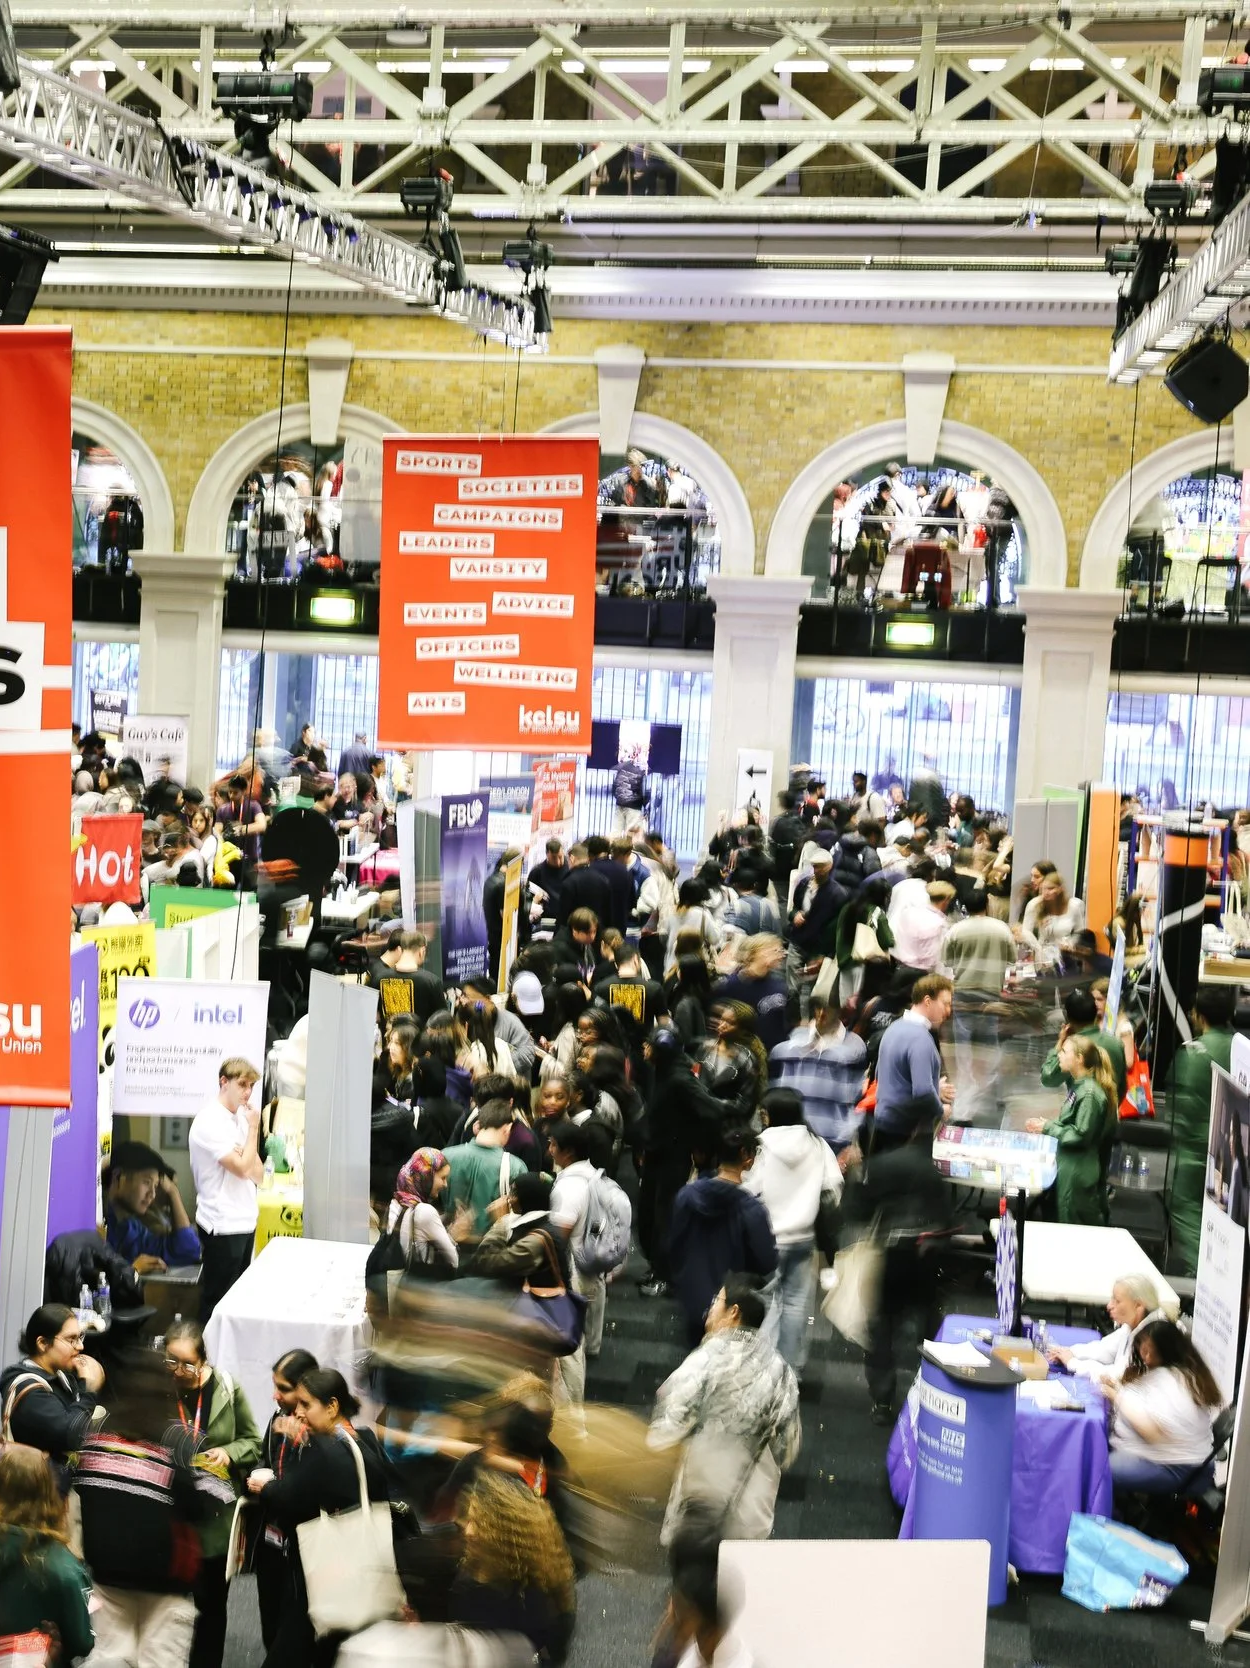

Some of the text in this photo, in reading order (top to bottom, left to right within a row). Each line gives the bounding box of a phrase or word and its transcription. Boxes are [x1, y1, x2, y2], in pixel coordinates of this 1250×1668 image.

[400, 455, 478, 471] SPORTS
[462, 479, 579, 494] SOCIETIES
[437, 508, 559, 525] CAMPAIGNS
[402, 535, 491, 550] LEADERS
[454, 561, 543, 575] VARSITY
[496, 597, 570, 611] ADVICE
[407, 607, 483, 619] EVENTS
[419, 638, 516, 653] OFFICERS
[458, 665, 573, 685] WELLBEING
[413, 696, 462, 709] ARTS
[519, 704, 580, 728] kclsu
[128, 726, 184, 742] Guy's Café
[129, 997, 160, 1029] hp
[1, 1037, 42, 1054] Union
[929, 1389, 959, 1416] hand
[942, 1427, 965, 1448] NHS
